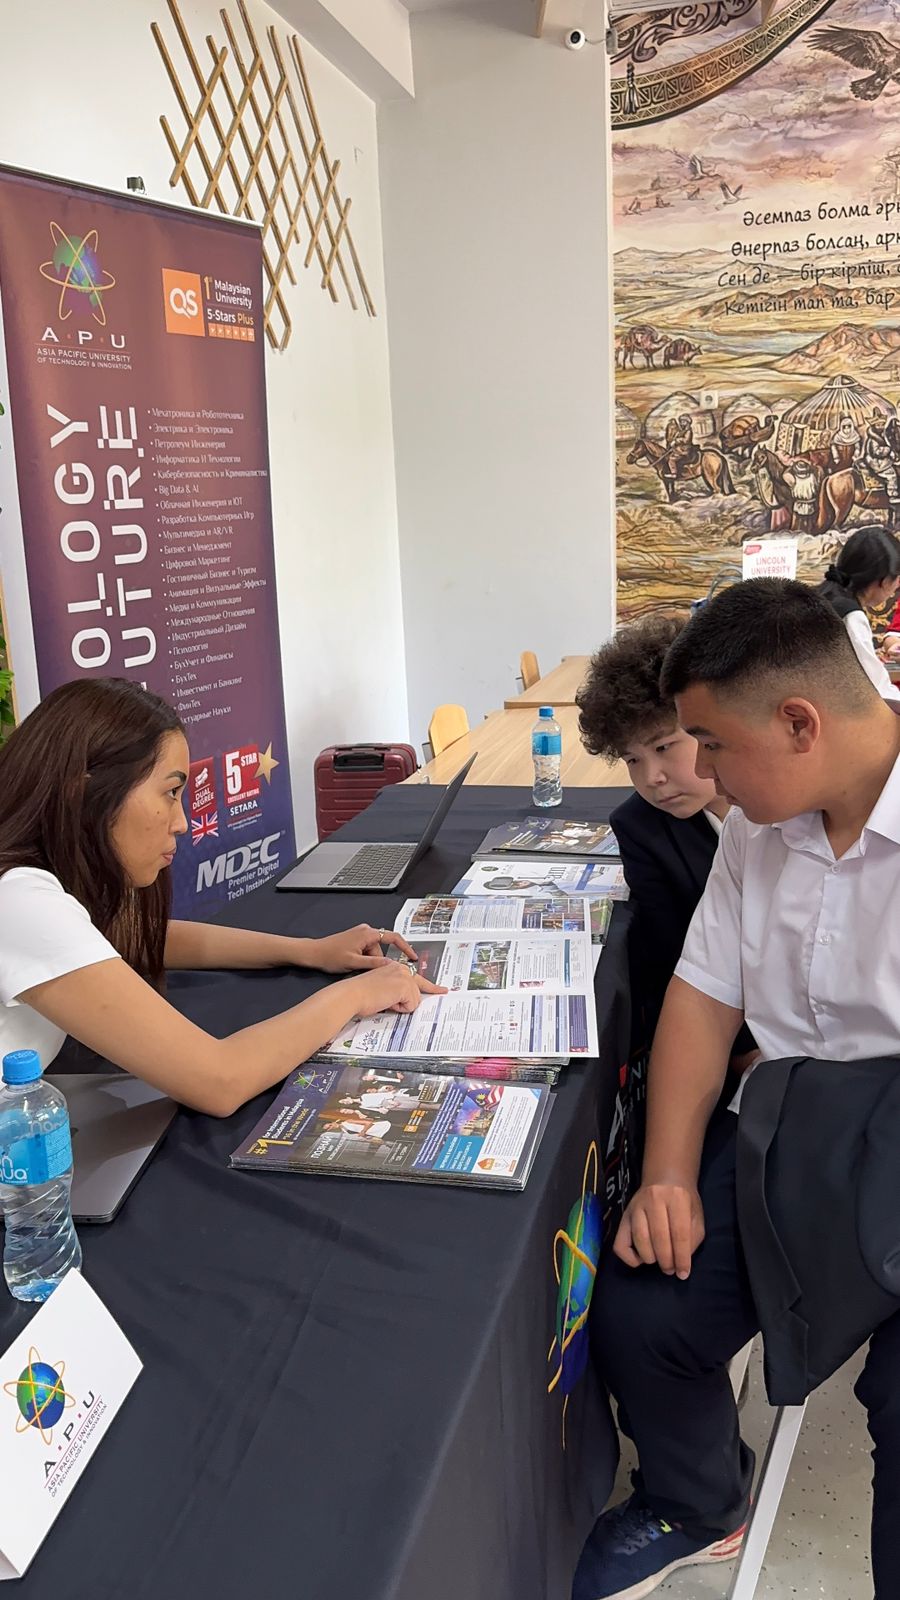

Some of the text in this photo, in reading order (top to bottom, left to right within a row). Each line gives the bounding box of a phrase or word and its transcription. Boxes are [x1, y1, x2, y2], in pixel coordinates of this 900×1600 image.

[743, 209, 812, 226] Әсемпаз
[817, 201, 871, 220] болма
[731, 239, 800, 262] Өнерпаз
[806, 232, 870, 251] болсаң,
[717, 271, 747, 288] Сен
[752, 266, 771, 285] де
[800, 263, 826, 285] бір
[214, 279, 252, 296] Malaysian
[168, 286, 199, 320] QS
[215, 291, 253, 310] University
[725, 297, 788, 316] Кетігін
[793, 297, 826, 311] тап
[865, 287, 895, 311] бар
[207, 308, 255, 326] 5-Stars Plus
[37, 348, 131, 363] ASIA PACIFIC UNIVERSITY
[49, 358, 90, 368] TECHNOLOGY
[97, 363, 132, 371] INNOVATION
[159, 485, 170, 496] Big
[170, 485, 185, 494] Data
[186, 485, 191, 493] &
[97, 405, 156, 690] UTURE
[164, 545, 186, 555] Бизнес
[192, 541, 232, 552] Менеджмент
[756, 556, 786, 565] LINCOLN
[209, 569, 231, 579] Бизнес
[236, 566, 257, 576] Туризм
[750, 565, 791, 576] UNIVERSITY
[169, 603, 190, 613] Медиа
[170, 607, 256, 627] Международные Отношения
[171, 622, 247, 642] Индустриальный Дизайн
[173, 642, 209, 656] Психология
[205, 652, 234, 664] Финансы
[176, 683, 212, 698] Инвестмент
[212, 705, 232, 717] Науки
[225, 750, 258, 795] 5 STAR
[192, 791, 215, 810] DEGREE
[195, 788, 211, 801] DUAL
[229, 799, 259, 817] SETARA
[196, 831, 281, 893] MDEC
[228, 859, 280, 889] Premier Digital
[227, 887, 245, 901] Tech
[271, 1120, 289, 1139] Students
[288, 1098, 304, 1116] Malaysia
[48, 1399, 104, 1493] ASIA PACIFIC UNIVERSITY
[51, 1486, 59, 1498] OF
[57, 1447, 83, 1488] TECHNOLOGY
[86, 1404, 108, 1440] INNOVATION
